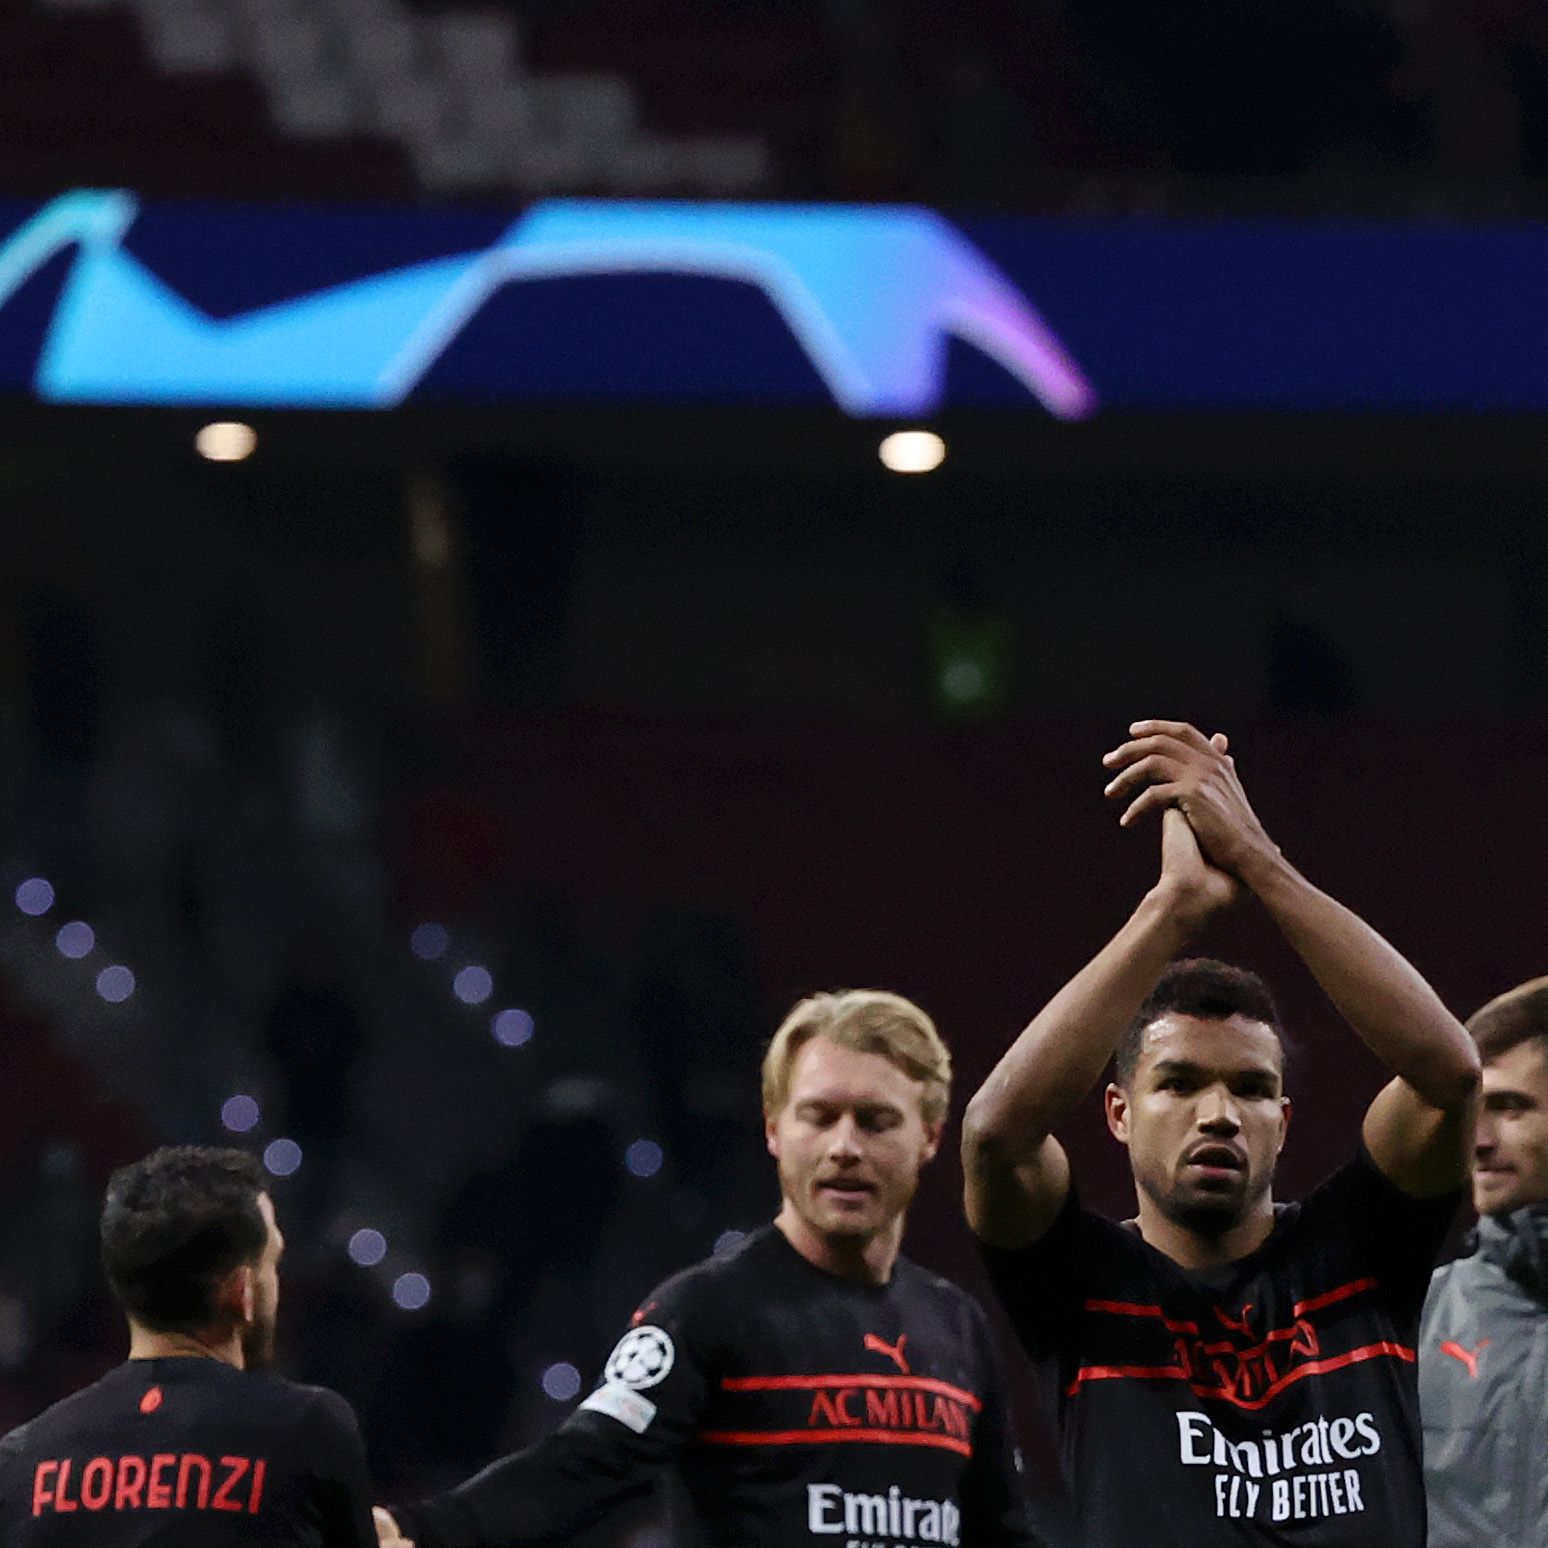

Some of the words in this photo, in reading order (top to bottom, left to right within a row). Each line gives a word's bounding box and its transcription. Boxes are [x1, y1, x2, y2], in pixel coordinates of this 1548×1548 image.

[808, 1388, 864, 1427] AC
[1176, 1411, 1381, 1478] Emirates
[31, 1452, 267, 1518] FLORENZI
[806, 1483, 961, 1547] Emirat
[1215, 1475, 1260, 1518] FLY
[1271, 1469, 1365, 1522] BETTER
